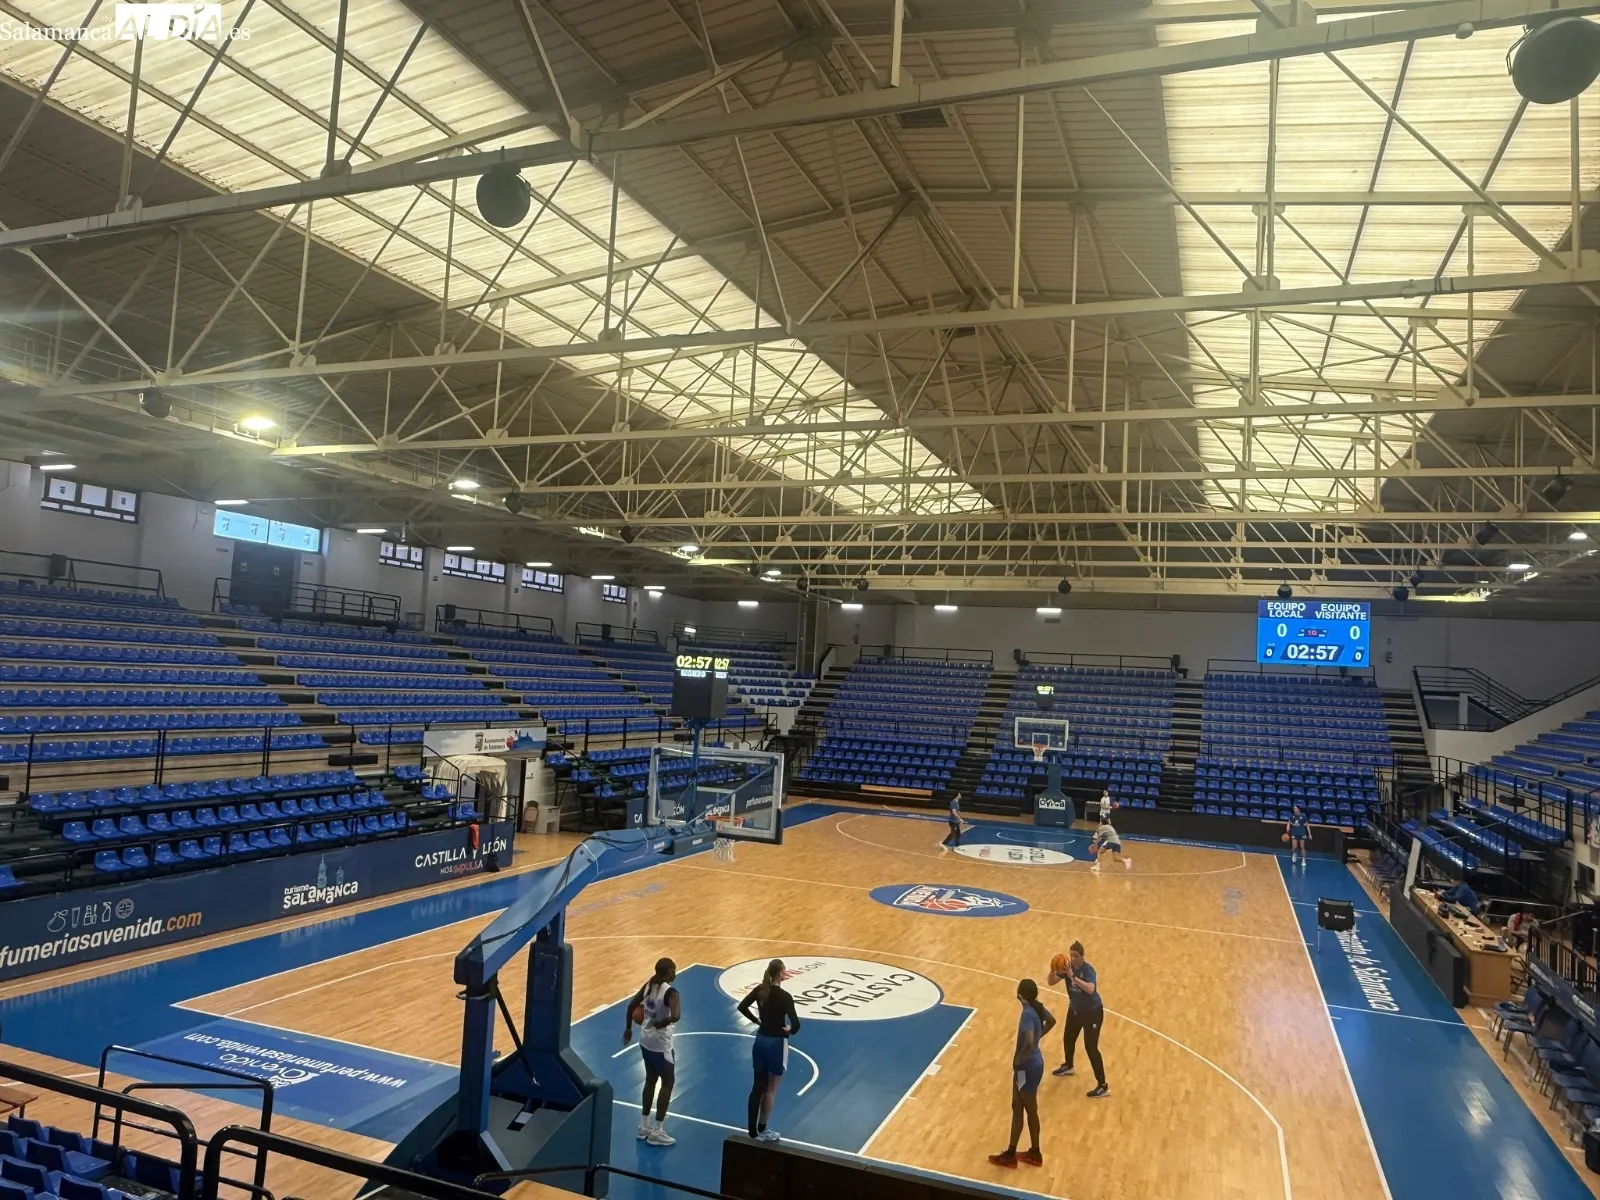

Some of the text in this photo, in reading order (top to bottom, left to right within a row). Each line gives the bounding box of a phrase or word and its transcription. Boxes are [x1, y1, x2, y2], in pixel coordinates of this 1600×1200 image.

[1267, 602, 1306, 612] EQUIPO
[1321, 603, 1360, 613] EQUIPO
[1269, 610, 1304, 619] LOCAL
[1315, 611, 1367, 620] VISITANTE
[1277, 623, 1288, 637] 0
[1349, 625, 1361, 640] 0
[1266, 648, 1273, 657] 0
[1287, 644, 1338, 660] 02:57
[1355, 652, 1362, 661] 0
[676, 654, 712, 669] 02:57
[415, 847, 467, 868] CASTILLA
[810, 973, 915, 1016] CASTILLA
